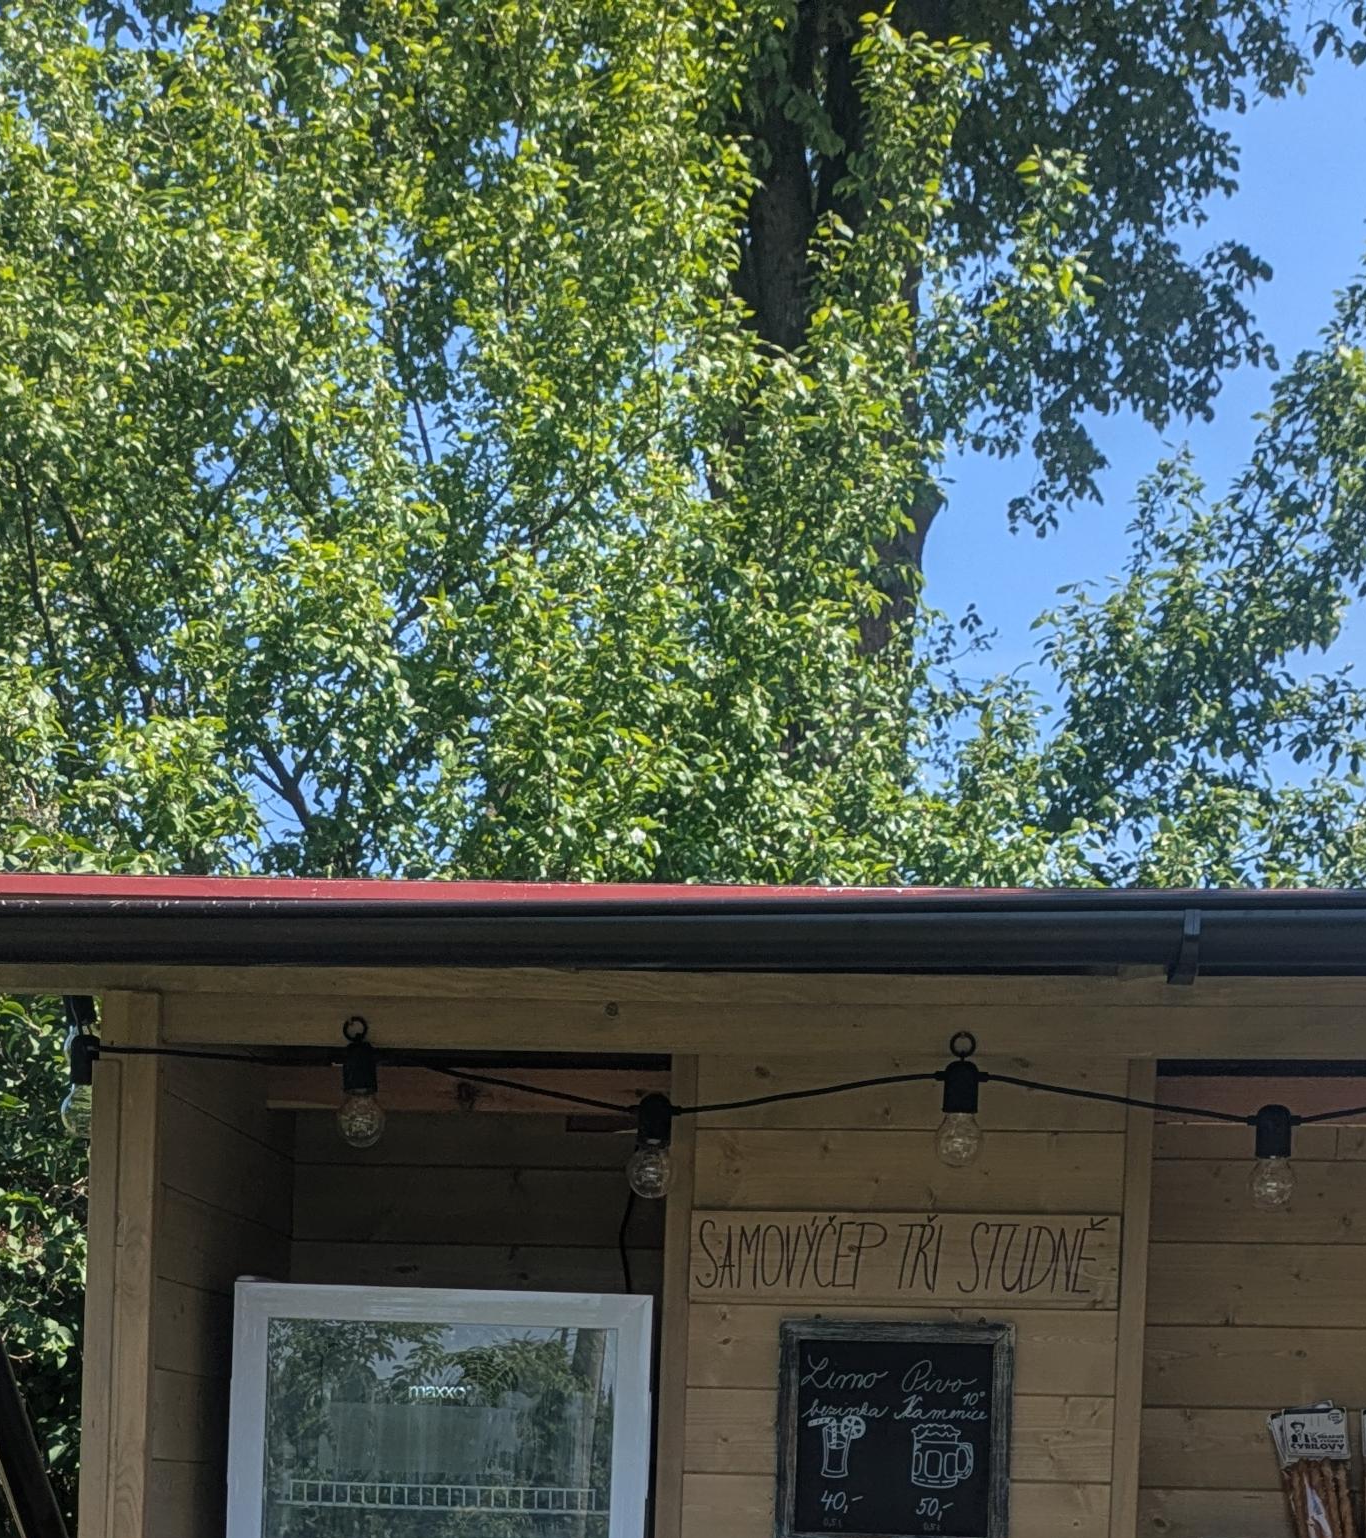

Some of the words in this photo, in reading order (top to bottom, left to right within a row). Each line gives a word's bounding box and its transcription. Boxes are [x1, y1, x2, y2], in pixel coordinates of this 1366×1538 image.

[695, 1215, 888, 1291] SAMOVÝČEP
[897, 1214, 943, 1292] TŘI
[957, 1217, 1109, 1294] STUDNĚ
[800, 1353, 889, 1390] Limo
[901, 1359, 978, 1394] Pivo
[801, 1398, 889, 1419] bezinka
[893, 1394, 988, 1421] Kamenice
